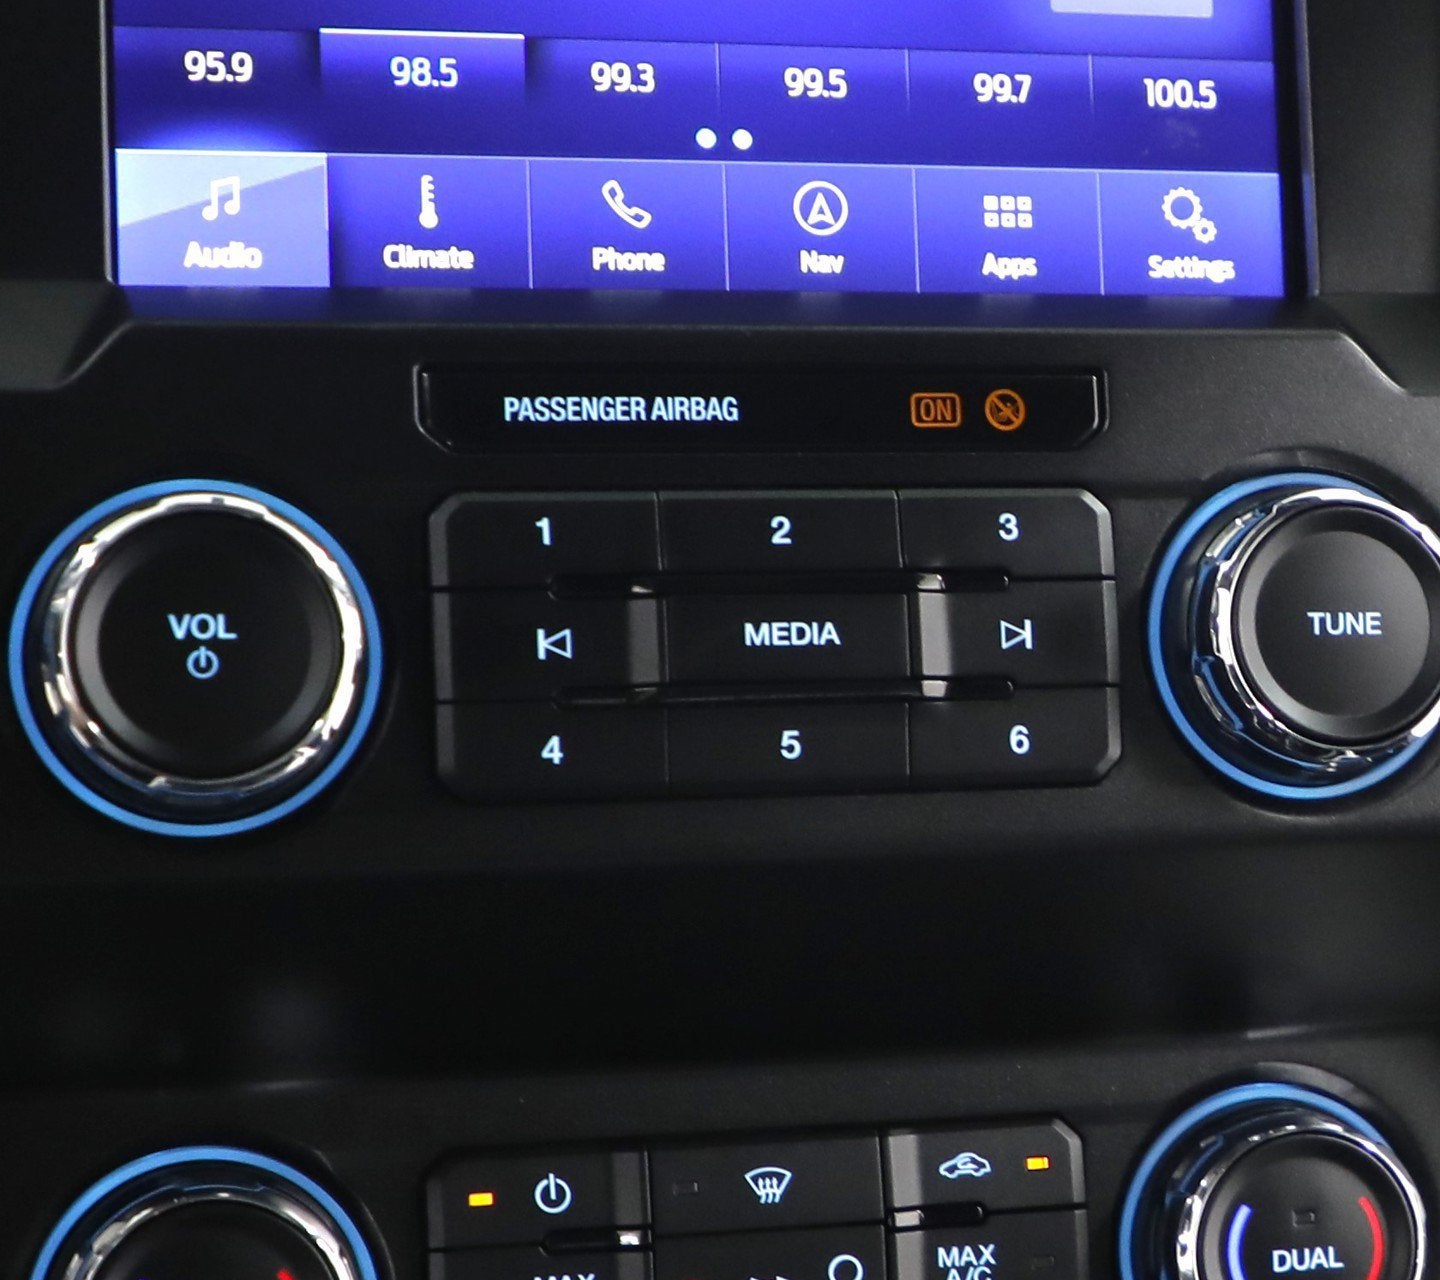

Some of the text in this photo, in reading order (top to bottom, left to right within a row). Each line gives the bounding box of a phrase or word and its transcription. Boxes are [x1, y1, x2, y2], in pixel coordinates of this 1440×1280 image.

[184, 50, 254, 83] 95.9
[390, 55, 459, 88] 98.5
[590, 61, 656, 94] 99.3
[783, 66, 848, 99] 99.5
[972, 72, 1033, 104] 99.7
[1142, 77, 1218, 110] 100.5
[182, 240, 264, 269] Audio
[382, 243, 475, 270] Climate
[591, 246, 666, 272] Phone
[799, 249, 845, 274] Nav
[981, 251, 1038, 281] Apps
[1147, 254, 1236, 284] Settings
[503, 395, 740, 423] PASSENGER AIRBAG
[920, 398, 952, 421] ON
[535, 517, 552, 546] 1
[770, 515, 793, 545] 2
[998, 512, 1020, 542] 3
[167, 612, 238, 641] VOL
[744, 621, 842, 647] MEDIA
[1306, 611, 1383, 637] TUNE
[540, 735, 564, 765] 4
[780, 729, 802, 760] 5
[1009, 724, 1031, 755] 6
[937, 1243, 996, 1269] MAX
[1272, 1245, 1345, 1274] DUAL
